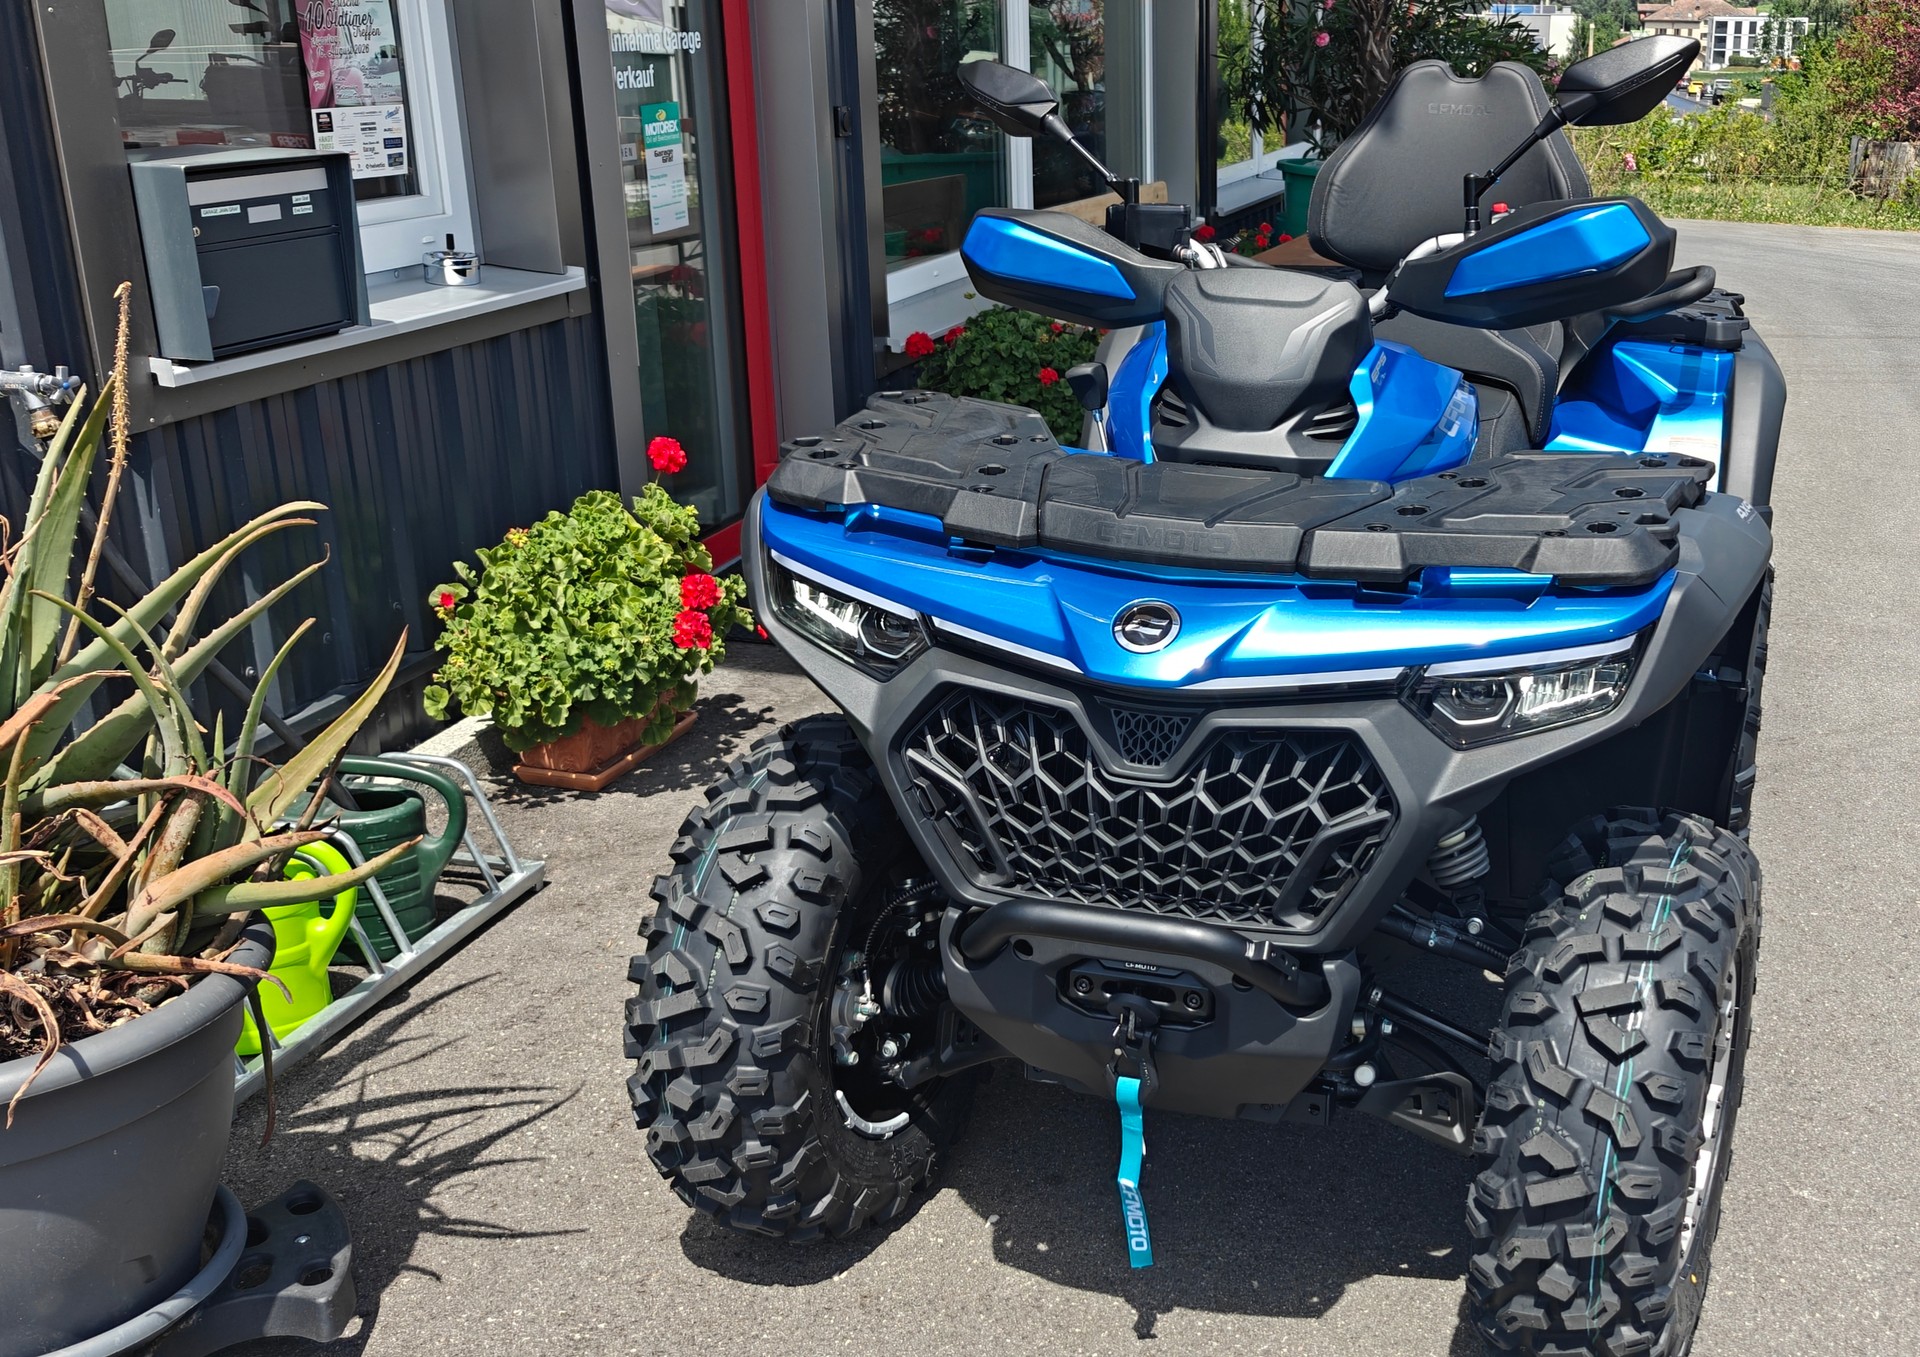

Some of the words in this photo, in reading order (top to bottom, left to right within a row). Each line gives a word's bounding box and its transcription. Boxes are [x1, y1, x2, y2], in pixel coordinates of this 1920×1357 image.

[353, 24, 381, 41] Treffen
[663, 26, 701, 54] Garage
[644, 119, 679, 137] MOTOREX
[1371, 351, 1387, 383] EPS
[1096, 520, 1232, 554] CFMOTO
